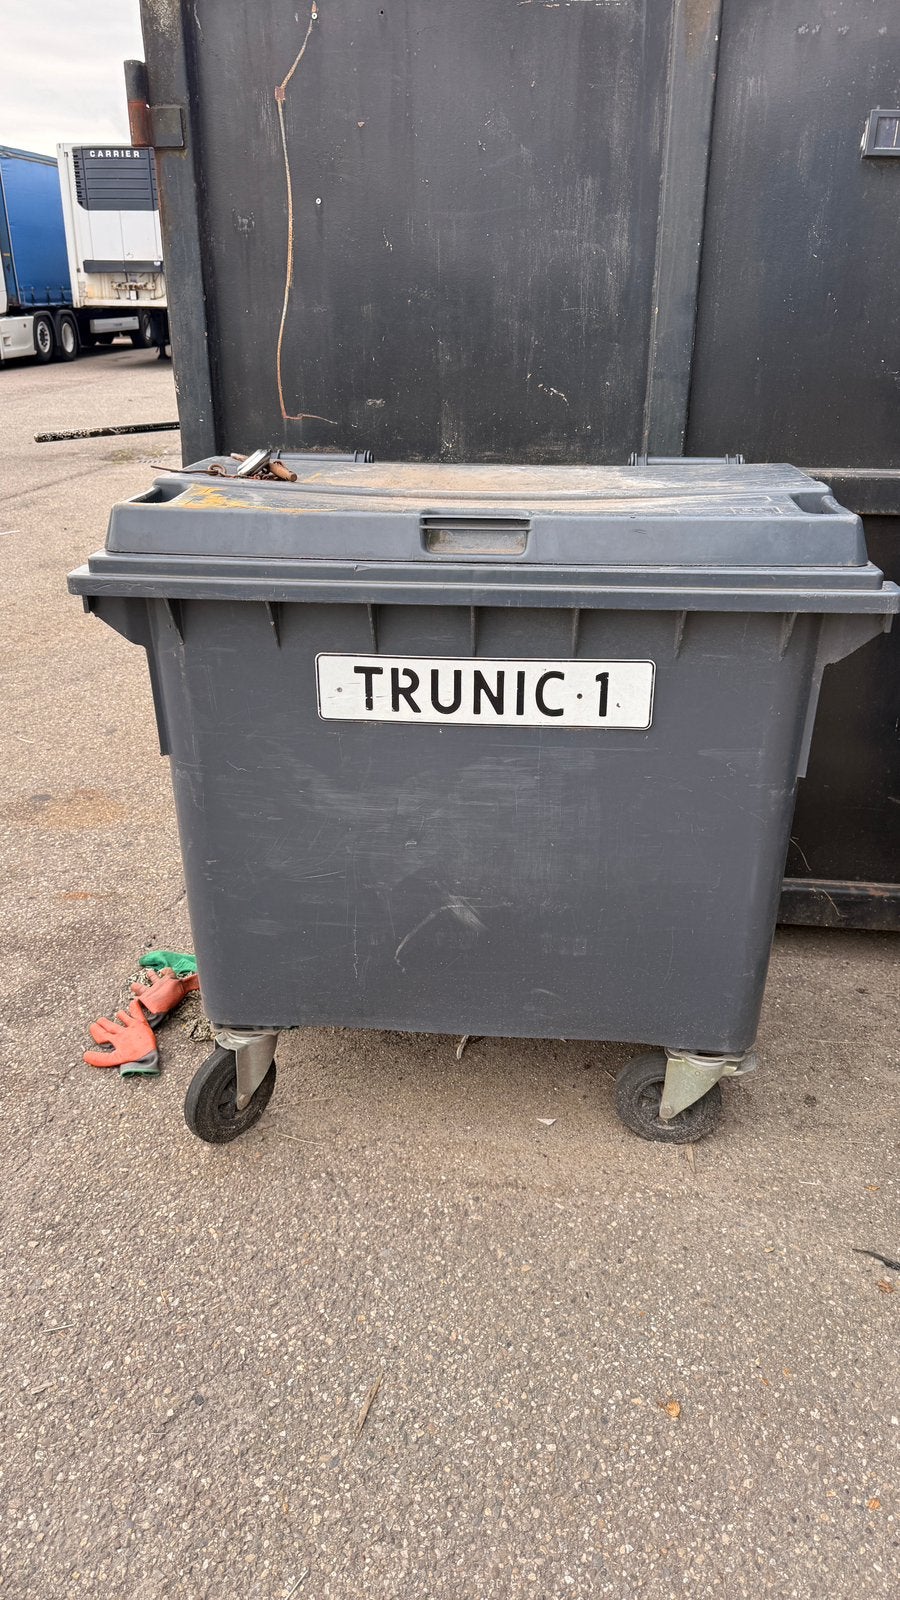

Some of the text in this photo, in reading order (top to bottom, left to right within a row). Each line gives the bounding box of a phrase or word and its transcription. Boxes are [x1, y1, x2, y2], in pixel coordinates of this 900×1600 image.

[89, 150, 140, 158] CARRIER
[353, 665, 609, 717] TRUNIC 1
